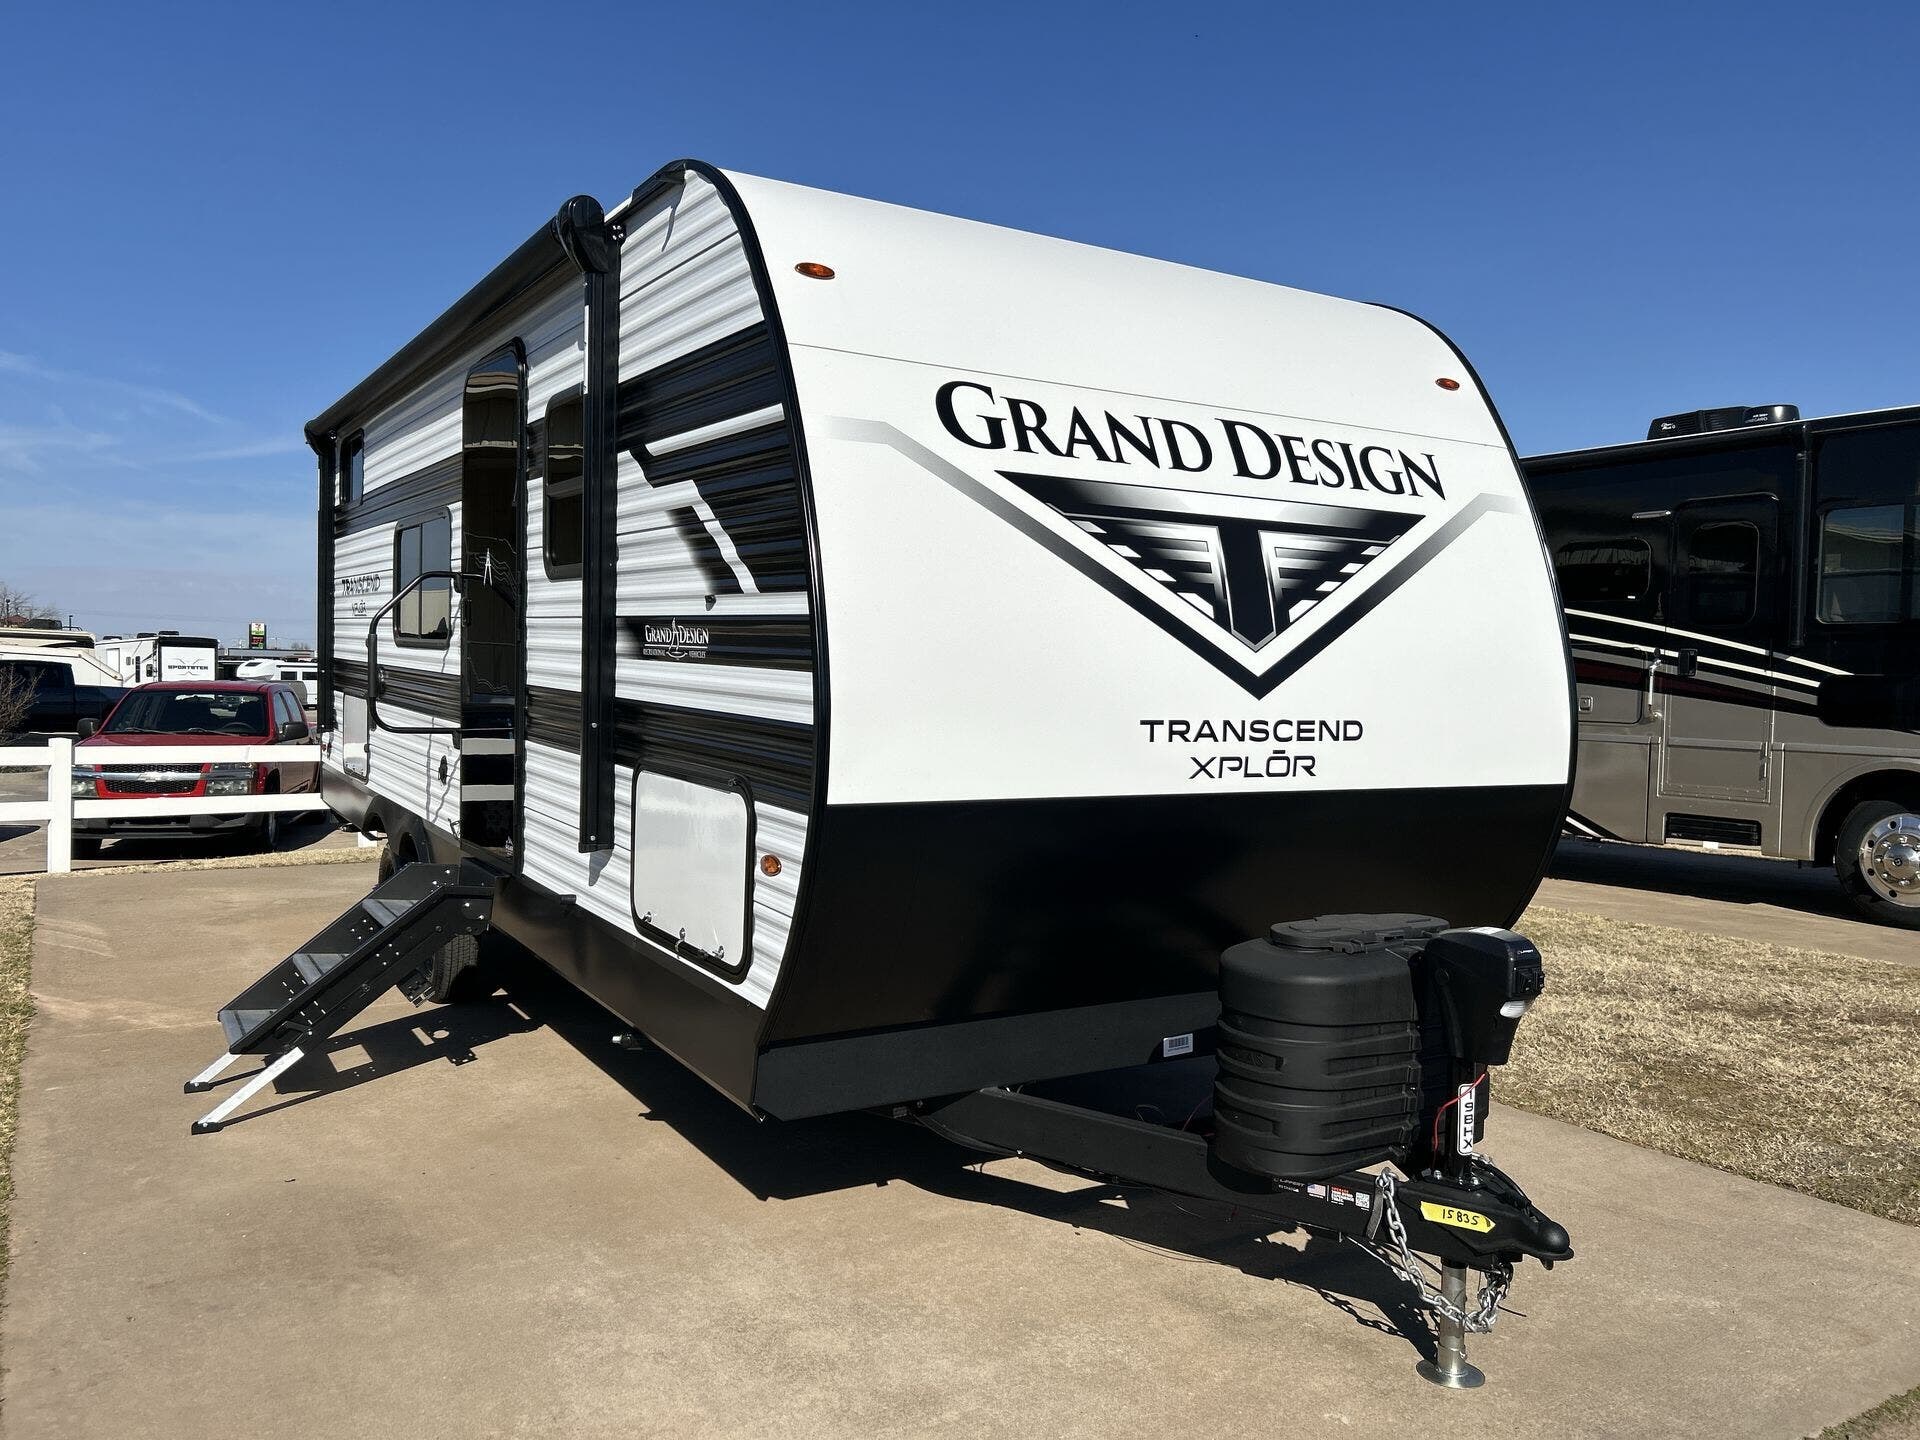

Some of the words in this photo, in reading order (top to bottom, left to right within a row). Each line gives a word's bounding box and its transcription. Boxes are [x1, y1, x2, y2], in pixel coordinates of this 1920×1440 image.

[935, 380, 1213, 473] GRAND
[1215, 417, 1447, 501] DESIGN
[644, 625, 672, 643] GRAND
[678, 625, 709, 644] DESIGN
[1139, 719, 1364, 743] TRANSCEND
[1442, 1208, 1480, 1226] 15835
